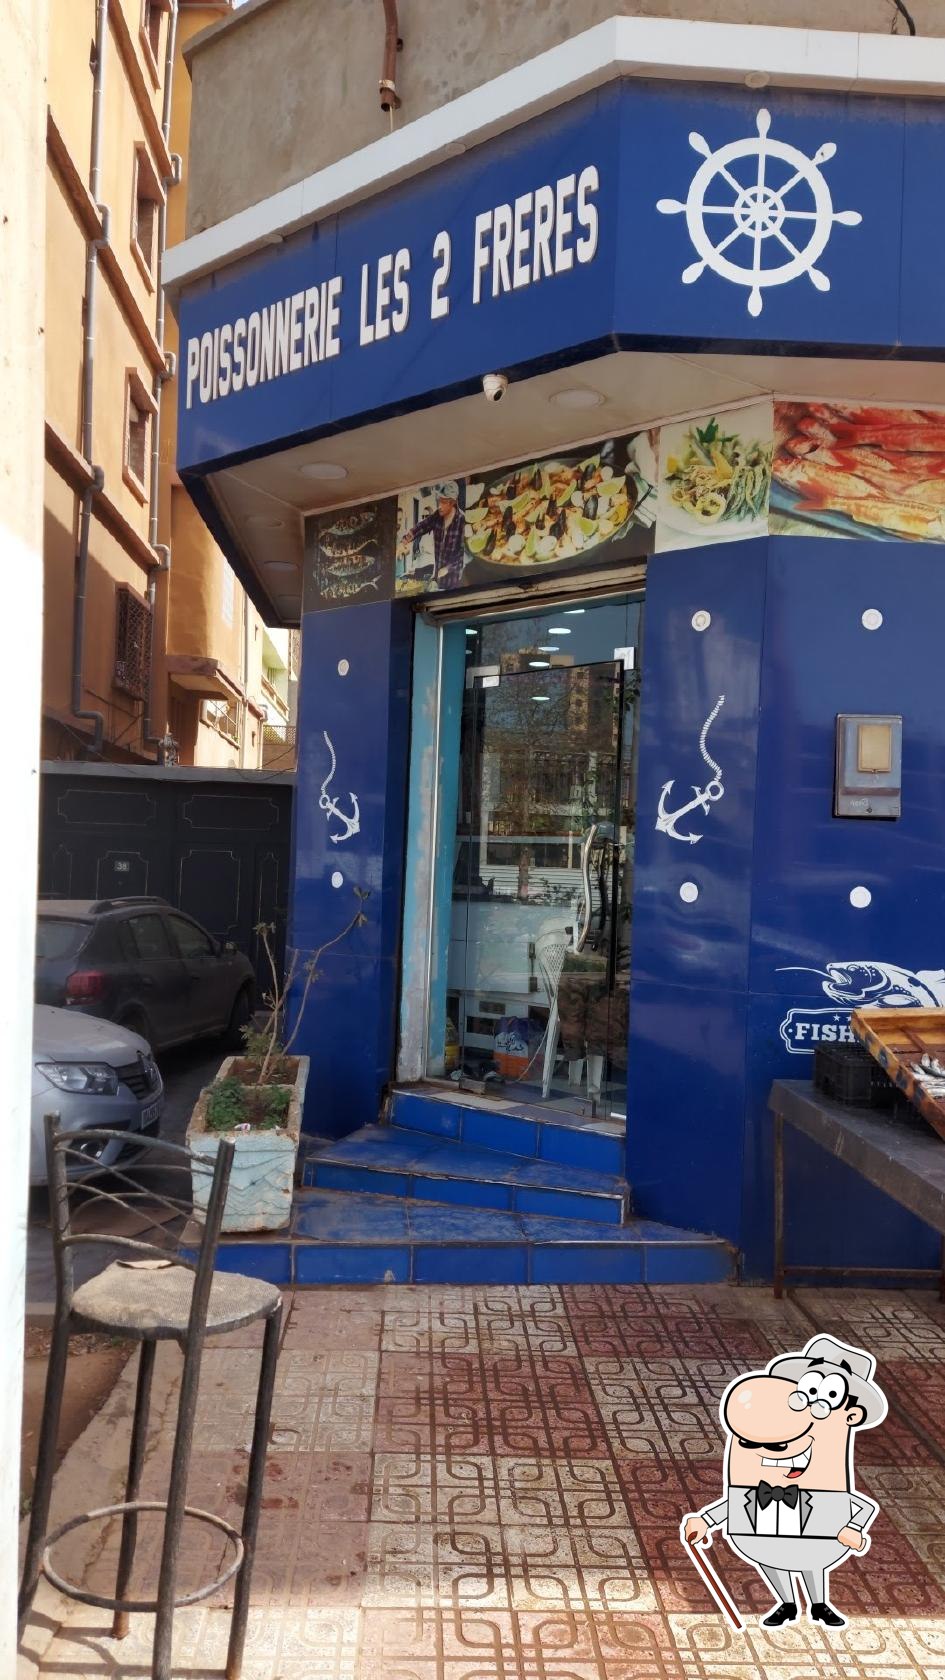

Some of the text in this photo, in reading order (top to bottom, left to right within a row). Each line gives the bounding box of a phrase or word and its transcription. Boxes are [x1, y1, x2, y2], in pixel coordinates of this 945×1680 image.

[186, 165, 600, 409] POISSONNERIE LES 2 FRERES
[795, 1023, 859, 1042] FISH
